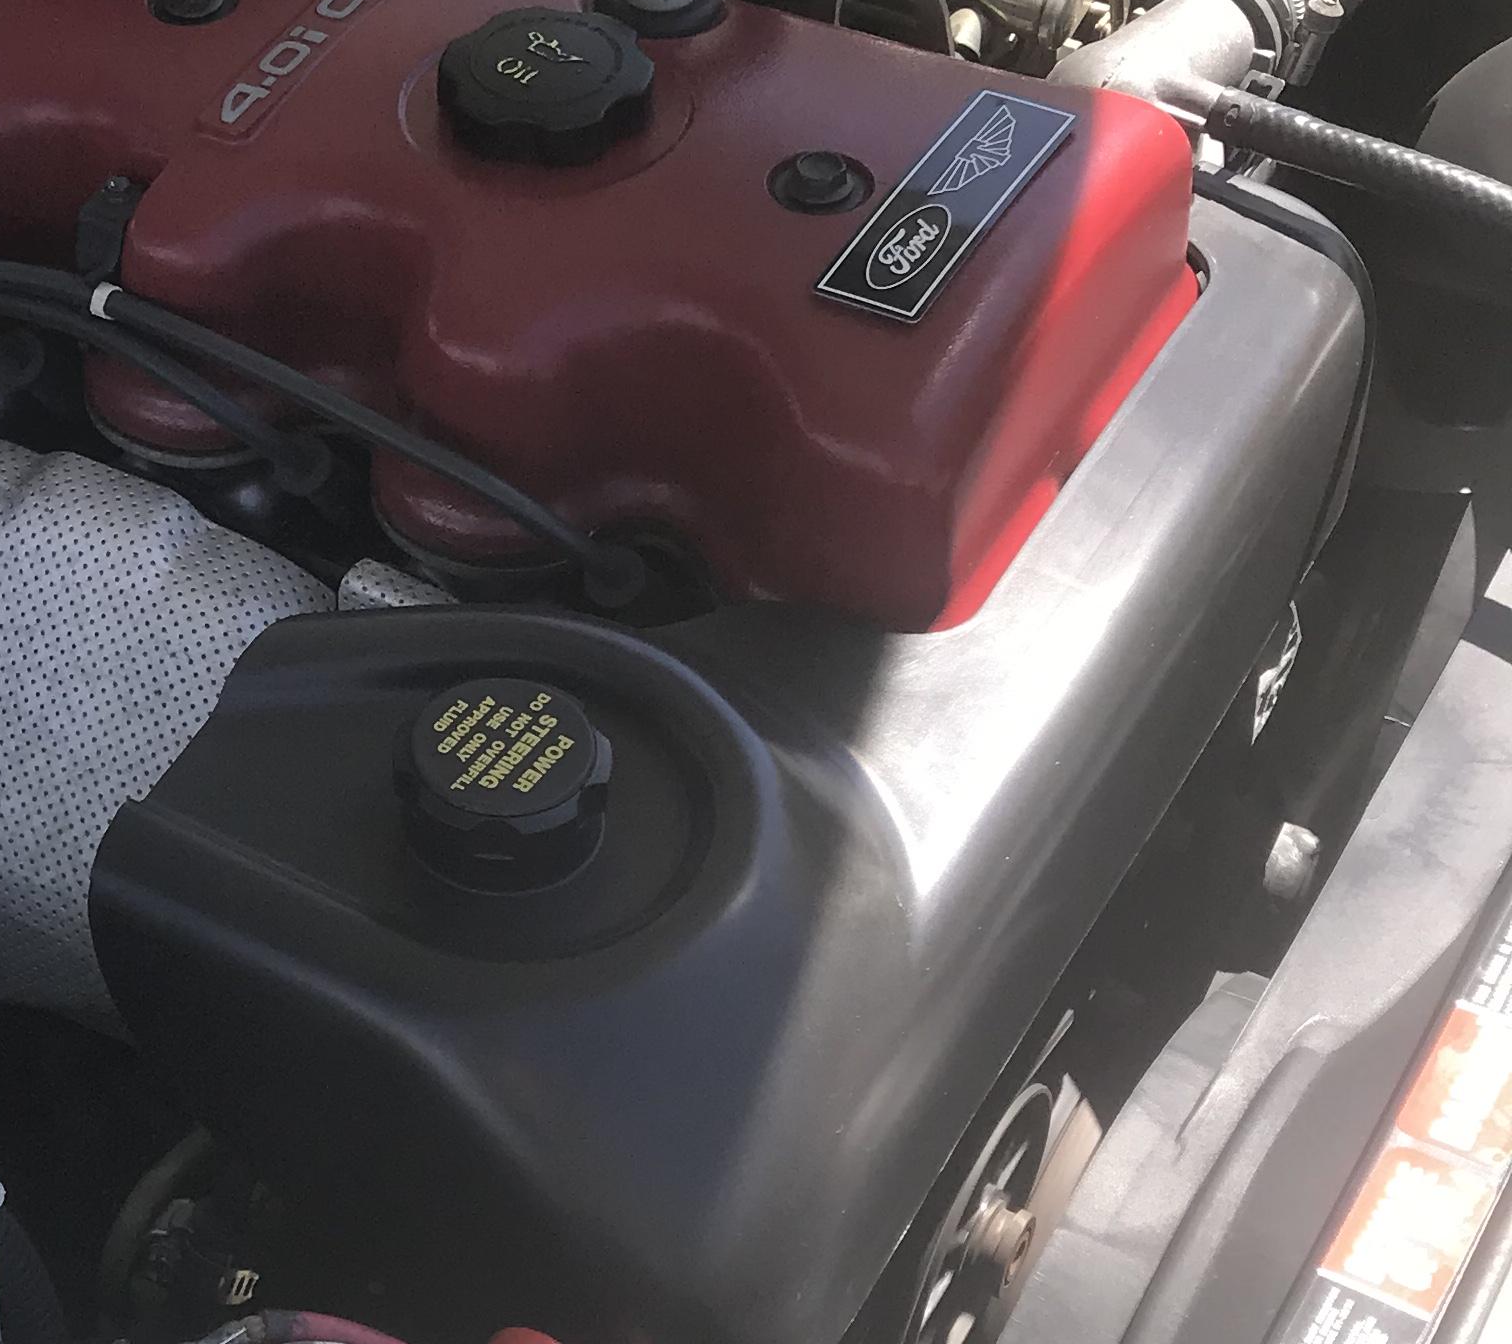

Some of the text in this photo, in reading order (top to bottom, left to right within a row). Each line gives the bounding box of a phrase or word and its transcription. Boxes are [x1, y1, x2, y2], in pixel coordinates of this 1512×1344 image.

[221, 27, 328, 123] 4.0i
[497, 57, 539, 84] Oil
[878, 219, 938, 274] Ford
[433, 700, 468, 732] FLUID
[438, 696, 496, 753] APPROVED
[450, 693, 551, 790] DO NOT OVERFILL
[456, 707, 513, 762] USE ONLY
[479, 714, 557, 788] STEERING
[513, 735, 575, 792] POWER
